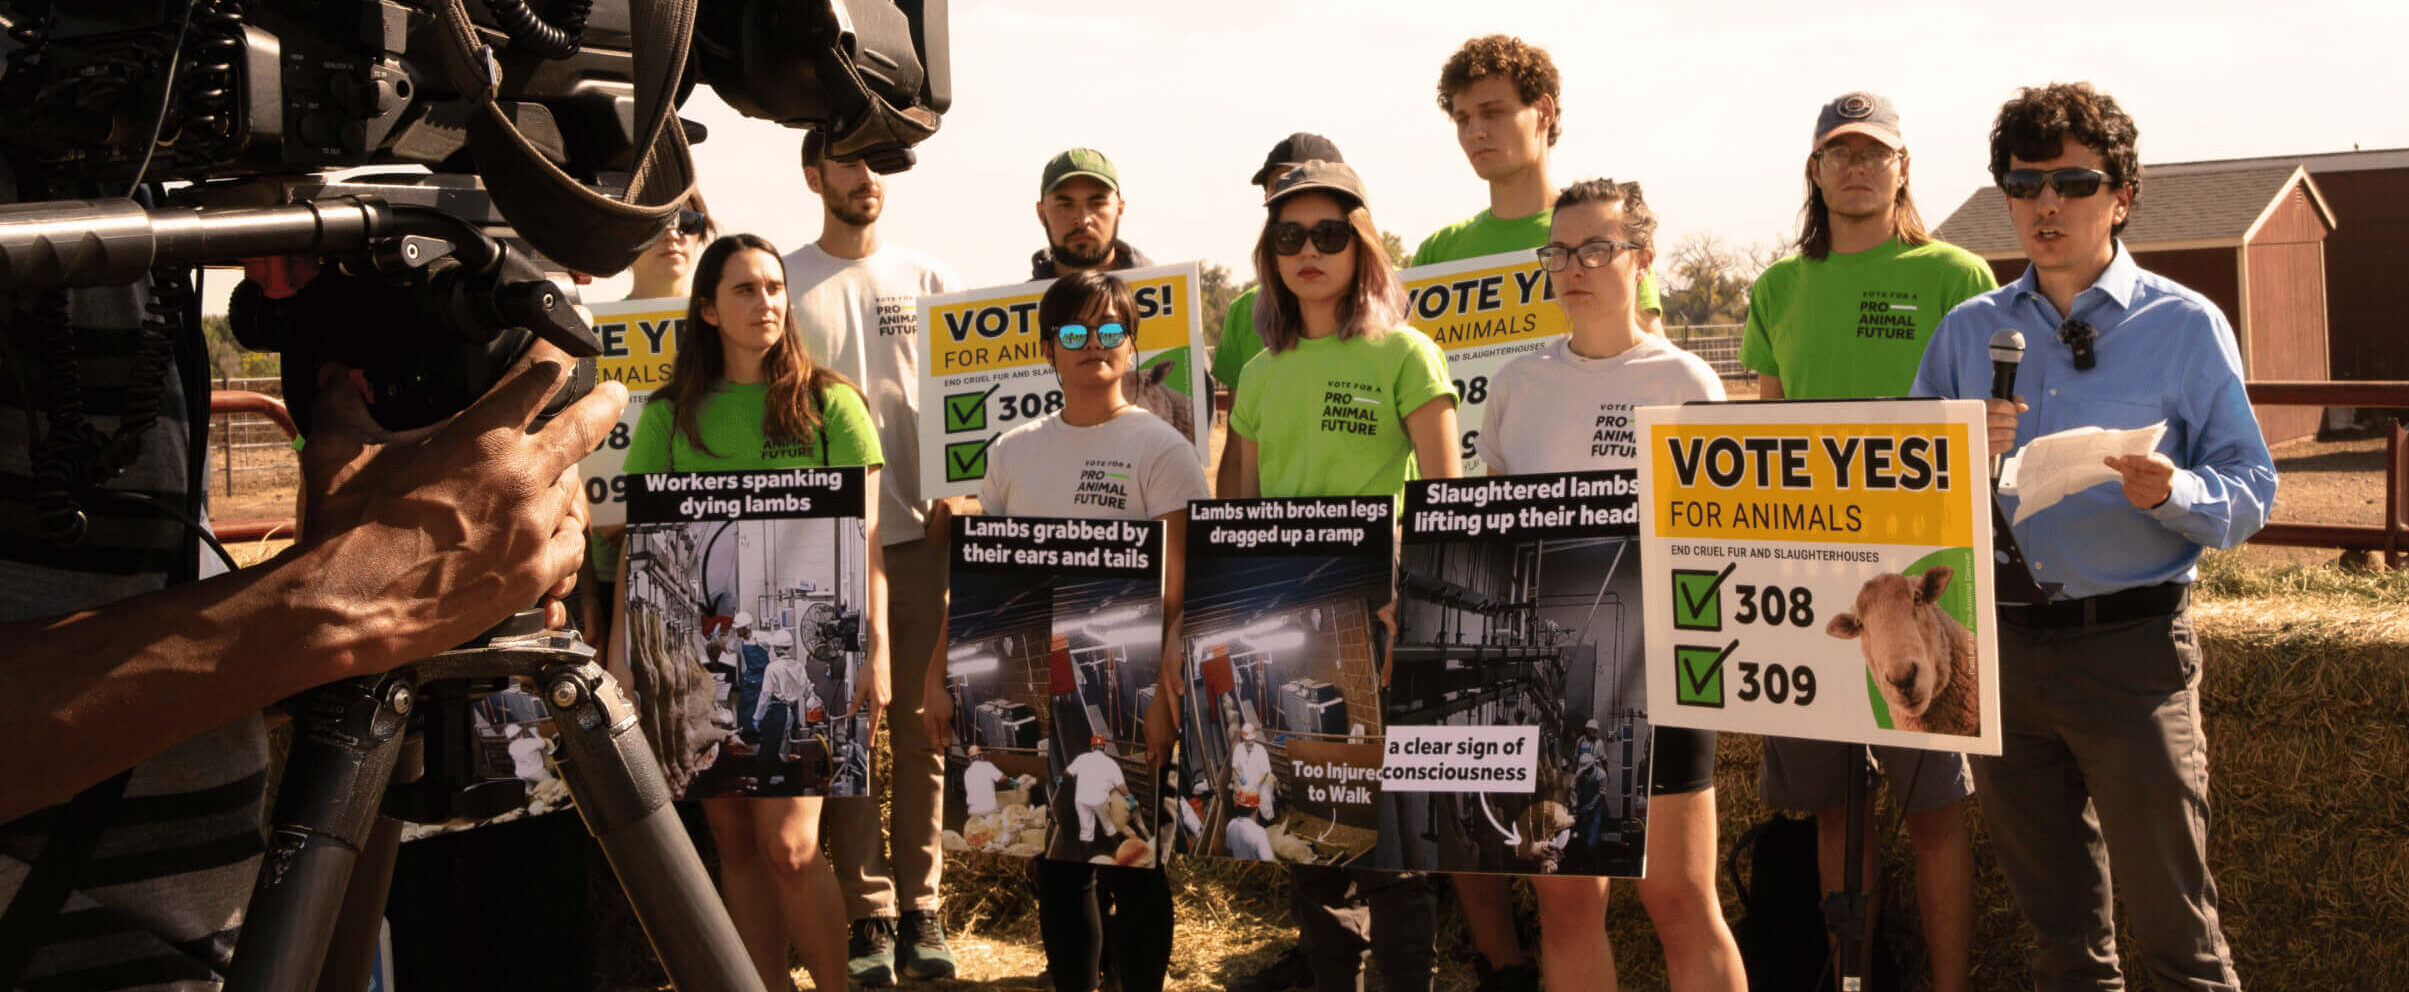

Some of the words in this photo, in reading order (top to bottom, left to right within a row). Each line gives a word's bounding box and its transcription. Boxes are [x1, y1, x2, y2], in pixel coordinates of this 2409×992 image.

[876, 305, 901, 315] PRO
[1860, 301, 1889, 312] PRO
[879, 315, 917, 326] ANIMA
[944, 302, 1038, 342] VOT
[1434, 313, 1537, 344] ANIMALS
[1859, 314, 1916, 327] ANIMAL
[1856, 326, 1915, 340] FUTURE
[945, 347, 989, 369] FOR
[1462, 342, 1545, 361] SLAUGHTERHOUSES
[944, 379, 962, 387] END
[963, 376, 991, 384] CRUEL
[993, 372, 1010, 381] FUR
[1012, 370, 1030, 379] AND
[1328, 381, 1351, 389] VOTE
[1353, 383, 1373, 392] FOR
[998, 390, 1064, 421] 308
[1324, 392, 1353, 405] PRO
[1322, 405, 1378, 422] ANIMAL
[1595, 416, 1628, 428] PRO
[1321, 419, 1377, 436] FUTURE
[1593, 430, 1636, 443] ANIM
[1667, 437, 1813, 489] VOTE
[1821, 436, 1950, 491] YES!
[645, 472, 738, 492] Workers
[742, 469, 842, 493] spanking
[1080, 470, 1105, 480] PRO
[1077, 482, 1128, 497] ANIMAL
[1426, 477, 1566, 508] Slaughtered
[1570, 474, 1639, 498] lambs
[679, 496, 741, 519] dying
[745, 494, 812, 513] lambs
[1073, 494, 1127, 510] FUTURE
[1191, 502, 1243, 521] Lambs
[1246, 501, 1284, 519] with
[1286, 500, 1347, 518] broken
[1350, 500, 1388, 522] legs
[1414, 511, 1481, 536] lifting
[1486, 515, 1515, 534] up
[1518, 506, 1575, 527] their
[1579, 502, 1640, 526] head
[1671, 500, 1722, 528] FOR
[1732, 502, 1863, 532] ANIMALS
[964, 517, 1030, 538] Lambs
[1033, 520, 1119, 544] grabbed
[1122, 522, 1149, 547] by
[1209, 525, 1278, 548] dragged
[1280, 529, 1302, 547] up
[1305, 530, 1315, 542] a
[1318, 527, 1365, 546] ramp
[962, 543, 1012, 564] their
[1014, 550, 1058, 566] ears
[1062, 547, 1100, 567] and
[1103, 548, 1149, 569] tails
[1671, 544, 1691, 556] END
[1693, 545, 1725, 558] CRUEL
[1727, 546, 1748, 558] FUR
[1750, 547, 1771, 559] AND
[1774, 548, 1879, 563] SLAUGHTERHOUSES
[1734, 584, 1815, 628] 308
[1737, 661, 1817, 707] 309
[1389, 741, 1400, 755] a
[1403, 737, 1453, 755] clear
[1456, 737, 1498, 760] sign
[1502, 737, 1526, 755] of
[1291, 760, 1324, 779] Too
[1382, 762, 1527, 782] consciousness
[1307, 786, 1326, 803] to
[1328, 785, 1372, 805] Walk
